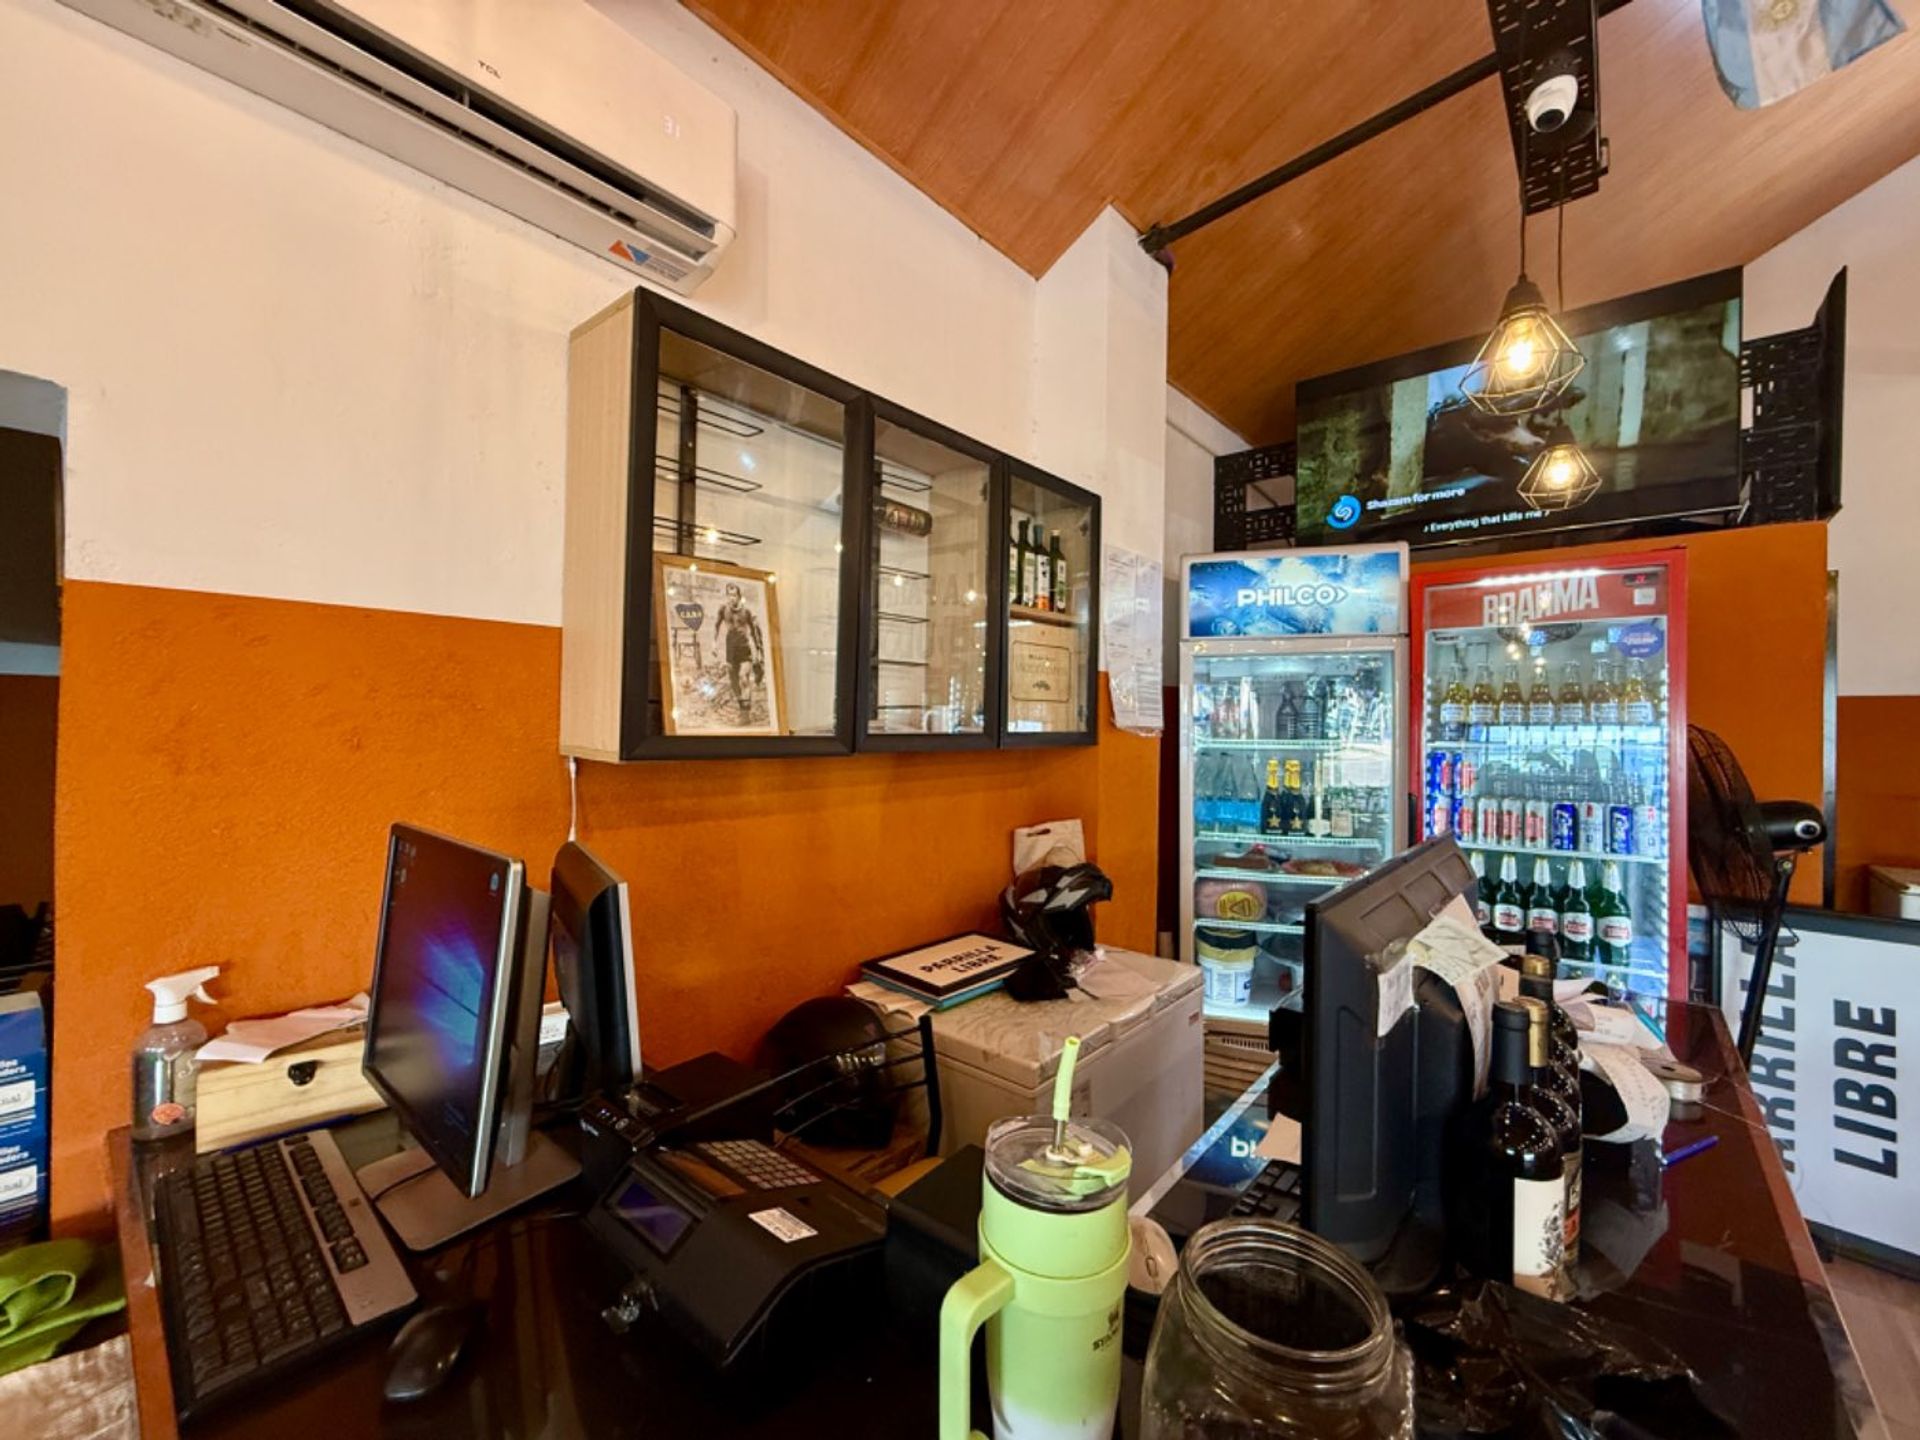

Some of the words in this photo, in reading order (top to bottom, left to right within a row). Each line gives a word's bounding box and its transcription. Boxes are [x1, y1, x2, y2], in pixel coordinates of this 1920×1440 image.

[478, 59, 501, 79] TCL
[1366, 495, 1411, 510] Shazam
[1412, 492, 1430, 503] for
[1431, 488, 1465, 500] more
[1430, 517, 1479, 533] Everything
[1480, 514, 1500, 525] that
[1503, 511, 1523, 521] kills
[1525, 509, 1542, 519] me
[1236, 584, 1337, 608] PHILCO
[1483, 575, 1600, 628] BRAHMA
[919, 945, 1000, 972] PARRILLA
[951, 954, 1002, 972] LIBRE
[1740, 930, 1796, 1174] RRILLA
[1833, 999, 1898, 1178] LIBRE
